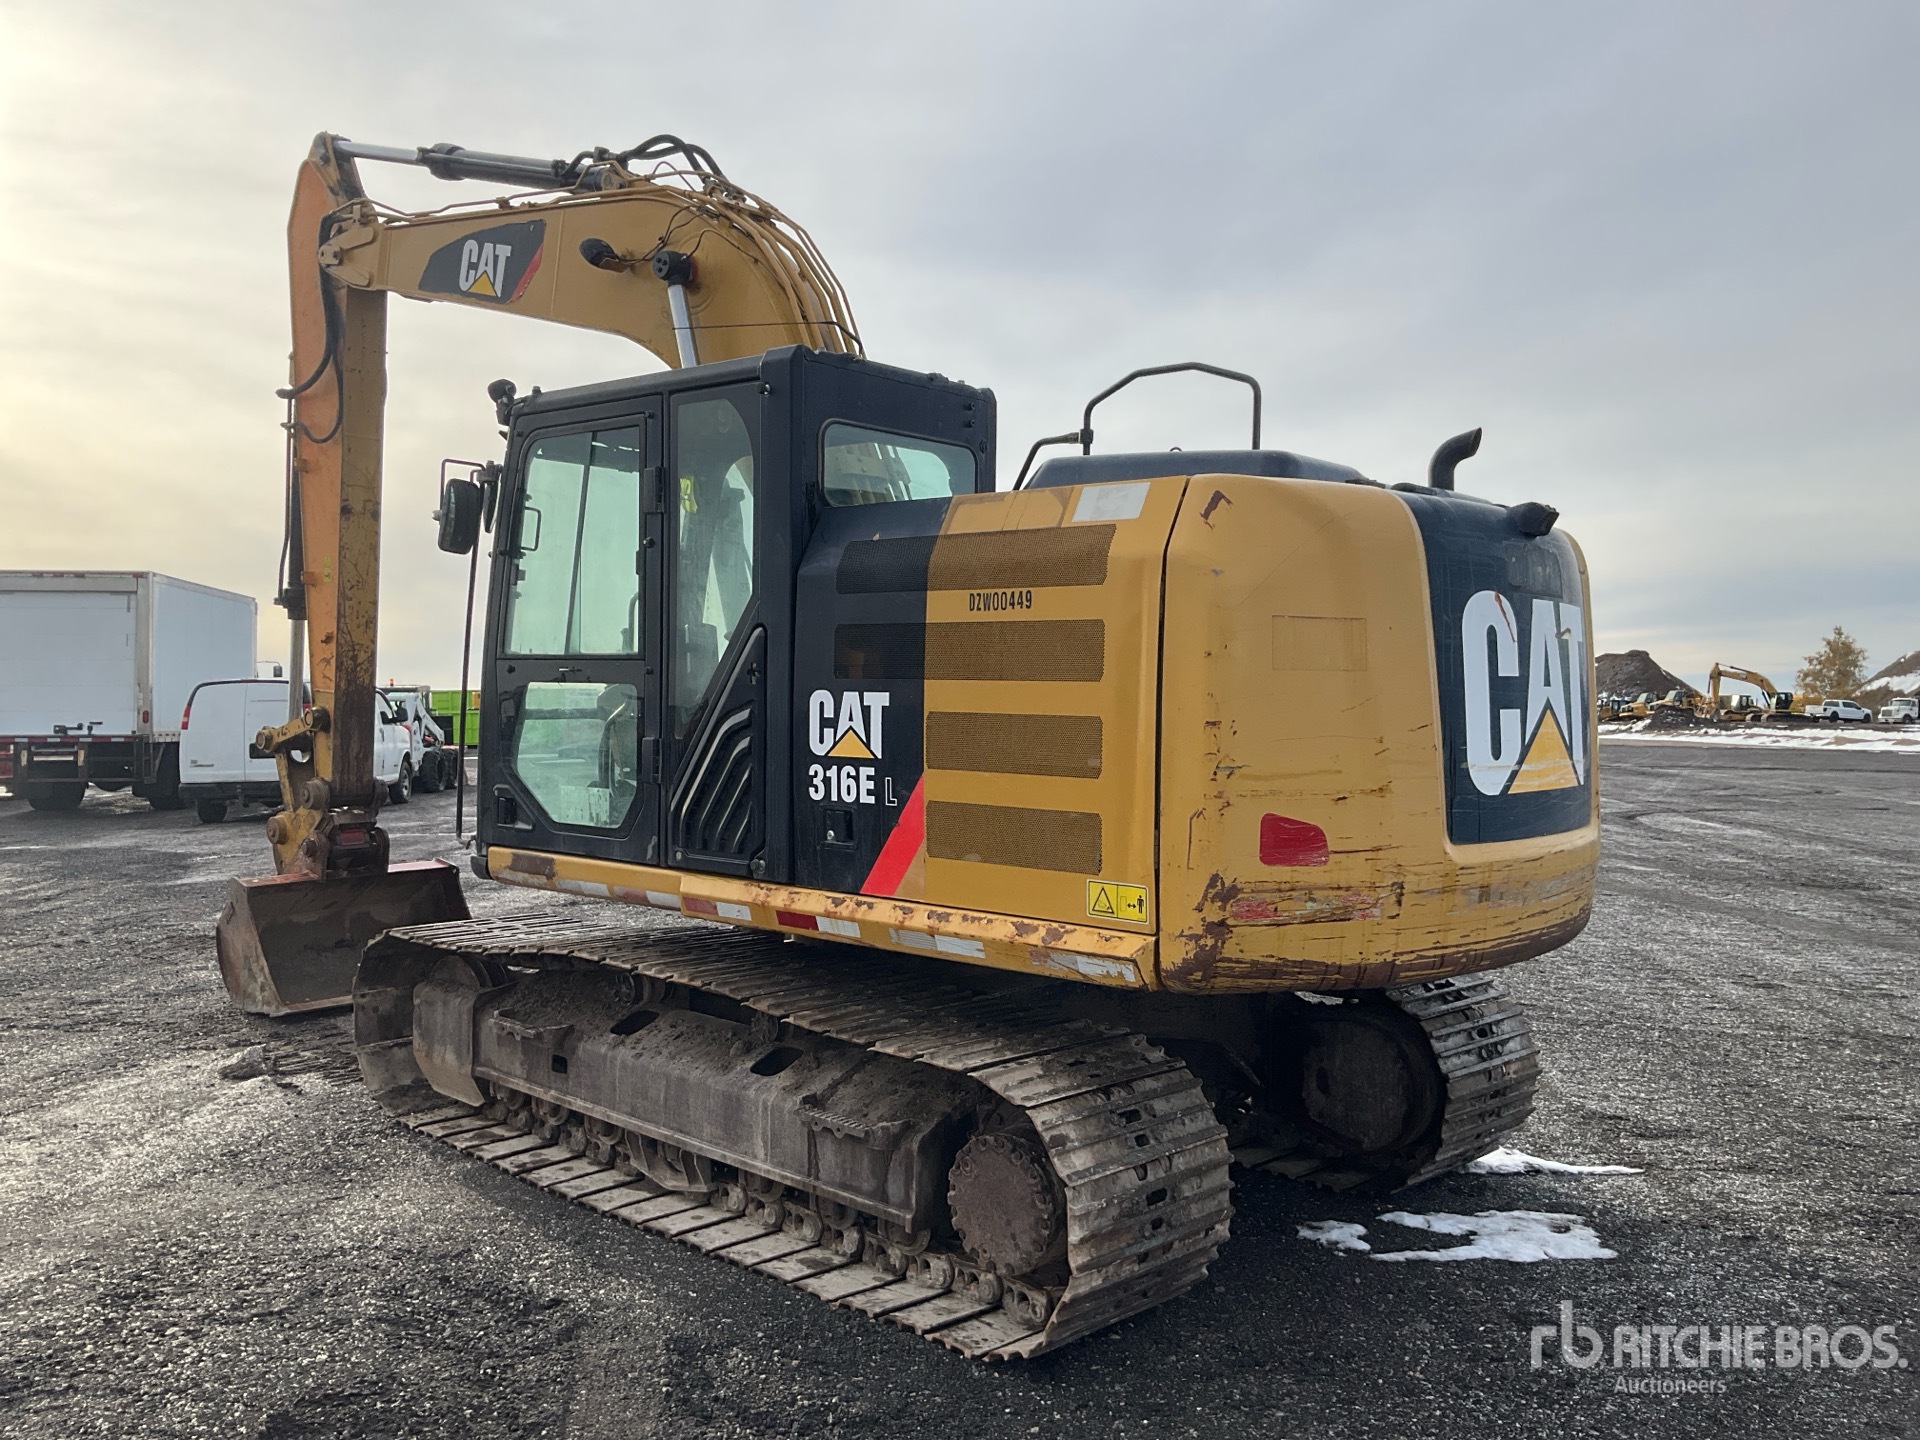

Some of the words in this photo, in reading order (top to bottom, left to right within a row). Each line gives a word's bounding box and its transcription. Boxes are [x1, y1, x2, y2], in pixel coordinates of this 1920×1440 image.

[458, 238, 512, 298] CAT
[968, 589, 1033, 612] DZW00449
[1461, 589, 1585, 796] CAT
[808, 688, 891, 760] CAT
[807, 763, 876, 805] 316E
[884, 776, 898, 807] L
